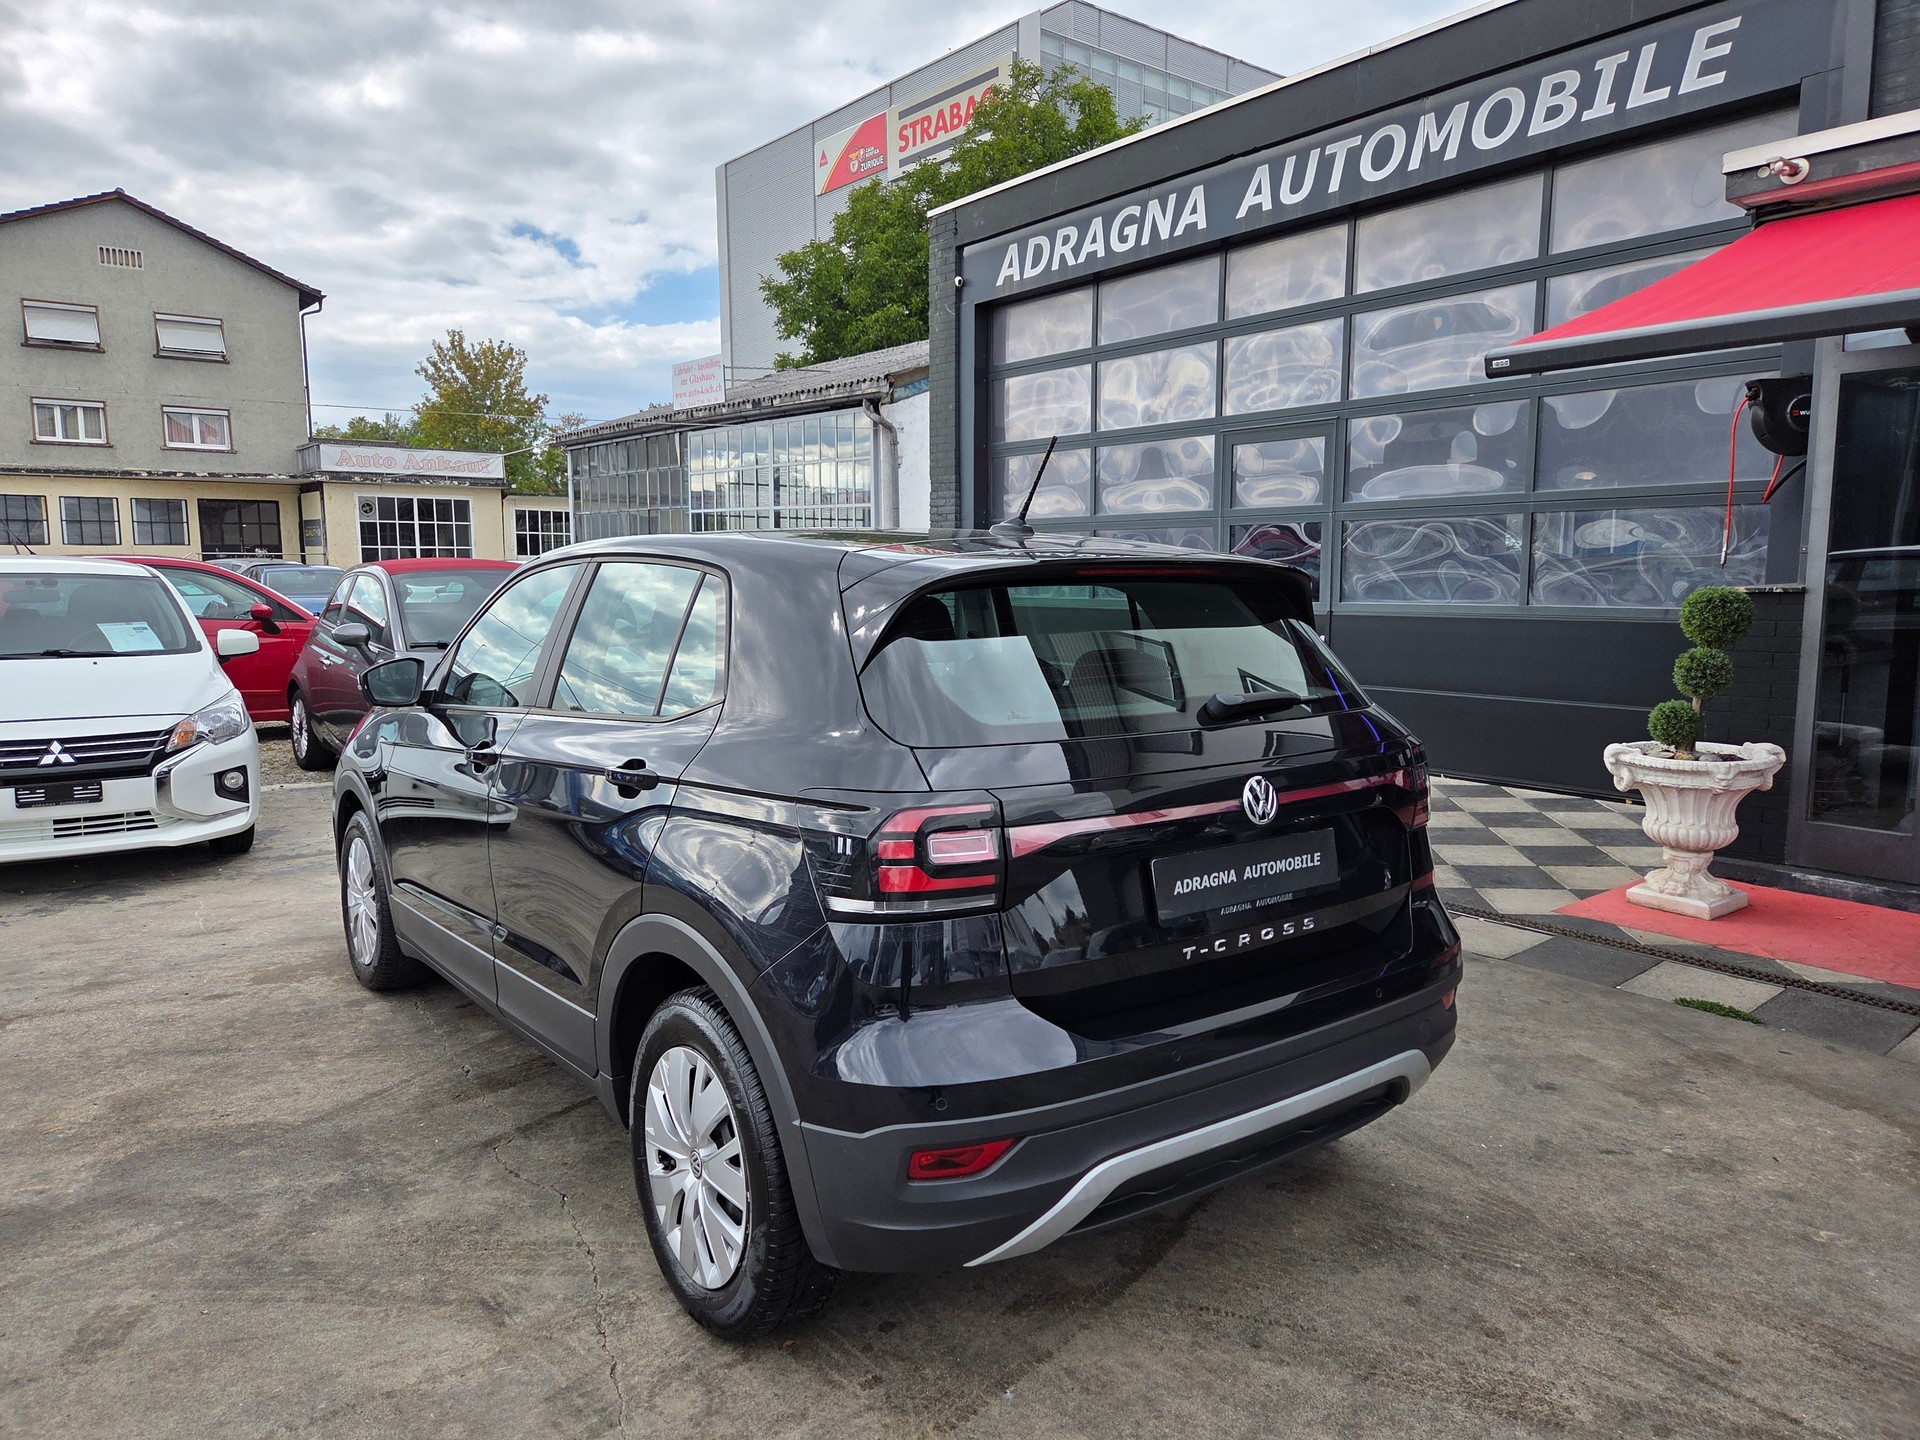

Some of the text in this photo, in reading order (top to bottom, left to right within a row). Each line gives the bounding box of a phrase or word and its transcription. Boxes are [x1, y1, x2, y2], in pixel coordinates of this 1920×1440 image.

[860, 155, 884, 172] ZURIQUE
[996, 16, 1742, 286] ADRAGNA AUTOMOBILE
[335, 450, 489, 473] Auto Ankauf
[1173, 852, 1321, 895] ADRAGNA AUTOMOBILE
[1220, 902, 1252, 916] ADRAGNA
[1182, 917, 1315, 960] T-CROSS
